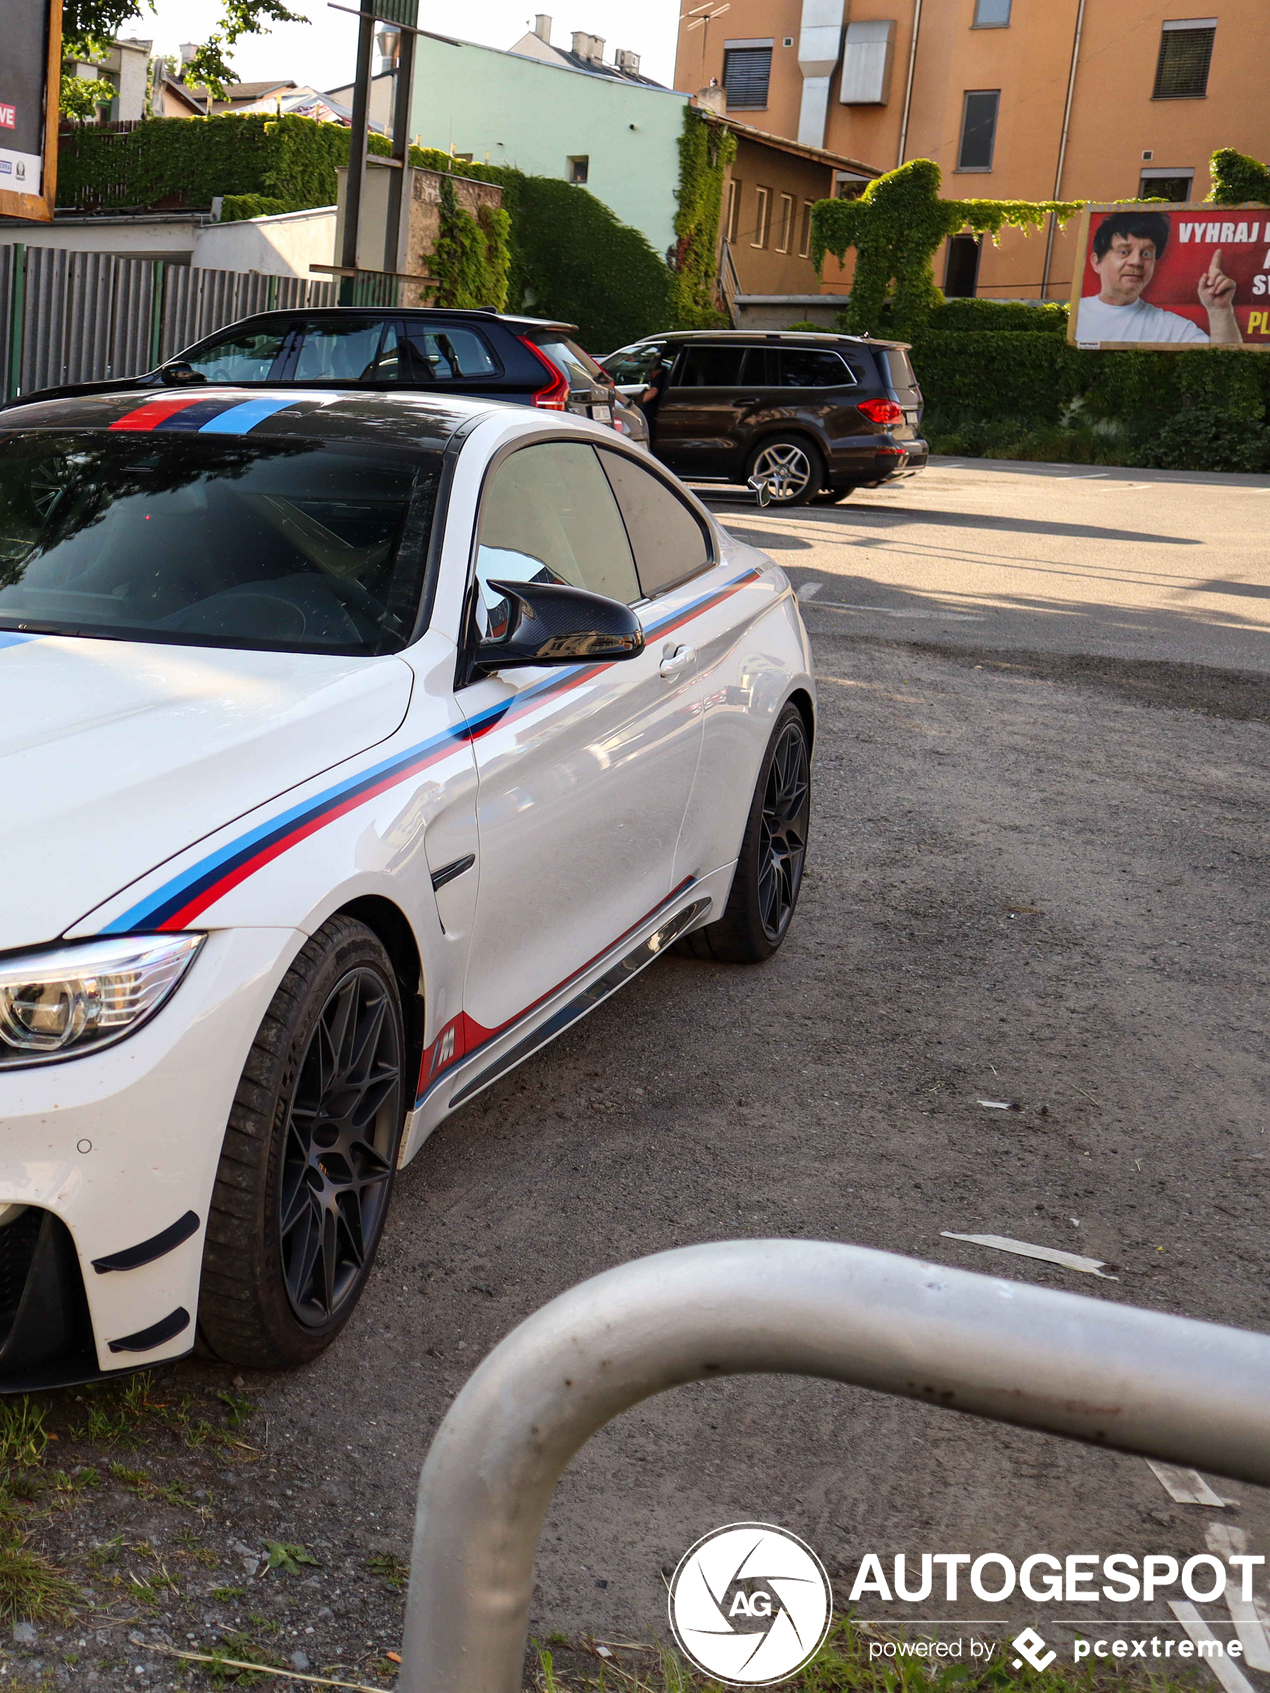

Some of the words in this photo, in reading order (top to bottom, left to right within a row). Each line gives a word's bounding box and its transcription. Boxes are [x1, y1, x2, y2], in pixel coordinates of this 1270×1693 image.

[1179, 222, 1260, 243] VYHRAJ
[1252, 275, 1270, 295] S
[1247, 311, 1270, 334] PL
